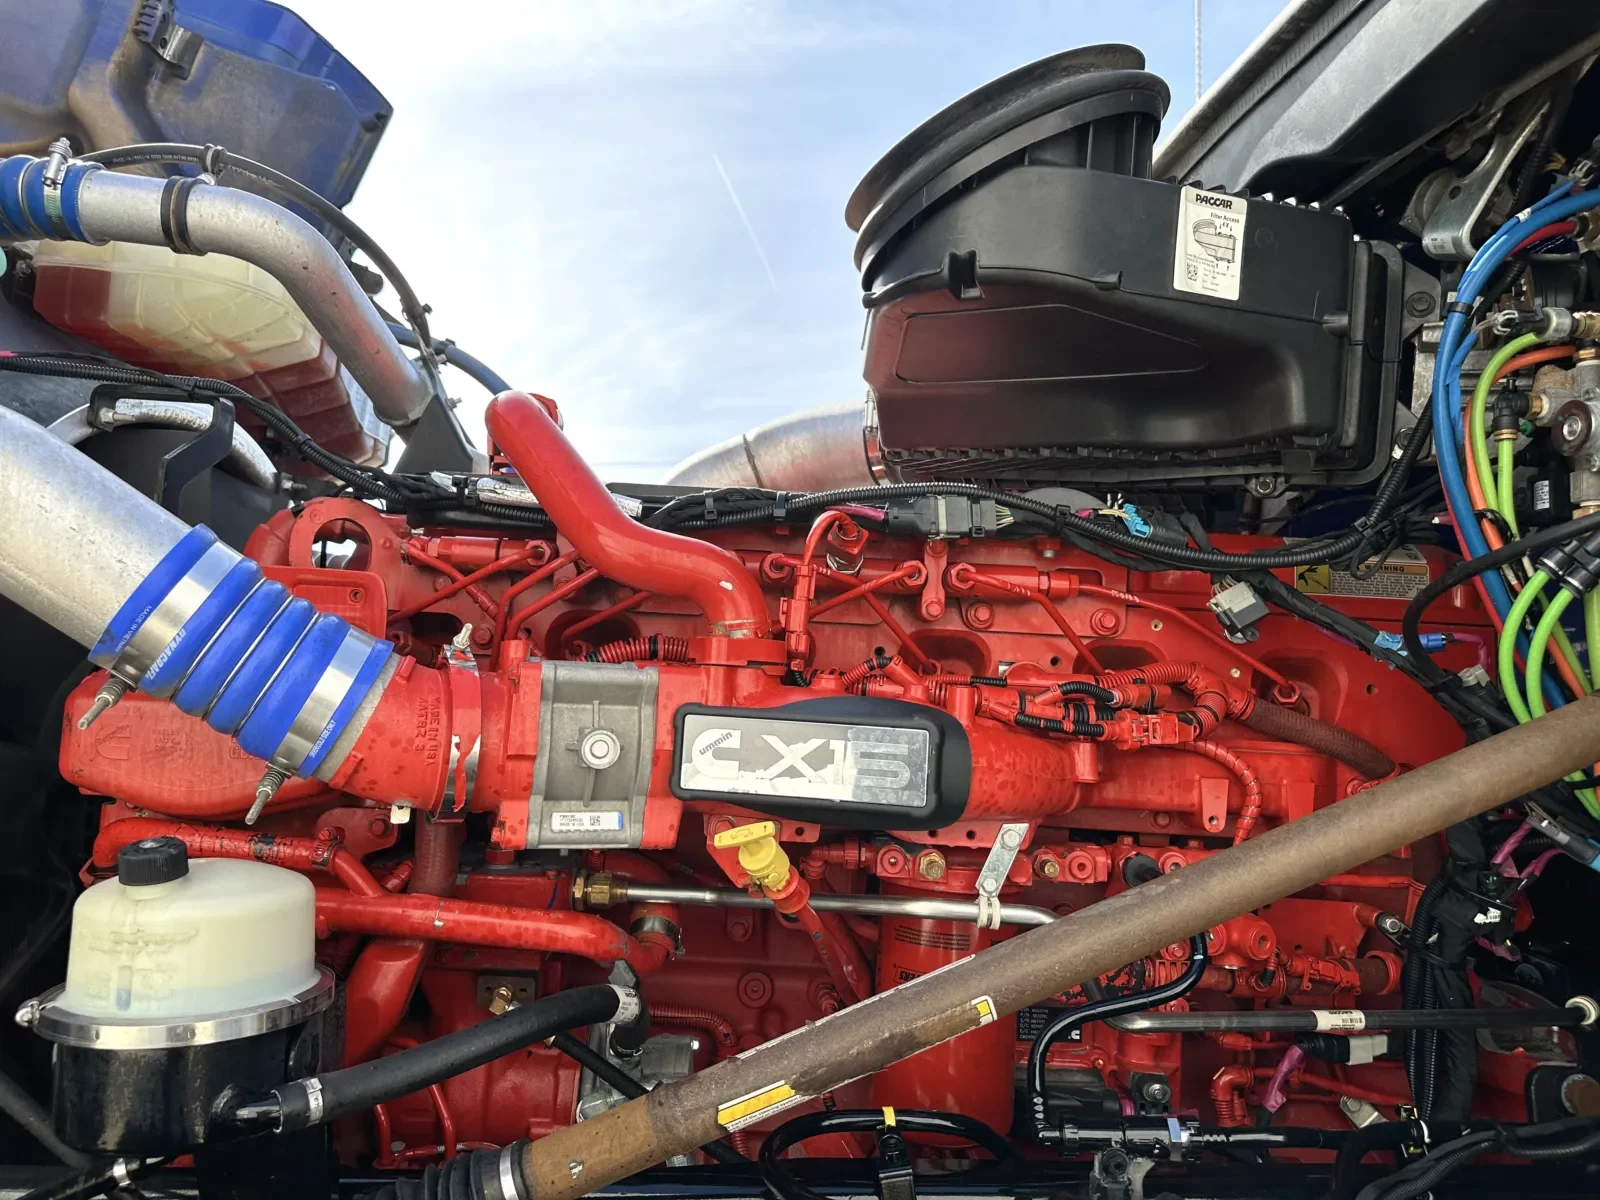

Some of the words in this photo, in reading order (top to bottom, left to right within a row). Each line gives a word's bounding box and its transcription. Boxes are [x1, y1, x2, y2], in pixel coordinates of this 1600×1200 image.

[1196, 193, 1233, 210] PACCAR
[1210, 212, 1222, 220] Filter
[1364, 564, 1404, 572] WNING
[137, 605, 152, 622] MADE
[130, 622, 138, 630] IN
[146, 628, 186, 680] DYNACRAFT
[760, 734, 911, 789] X15
